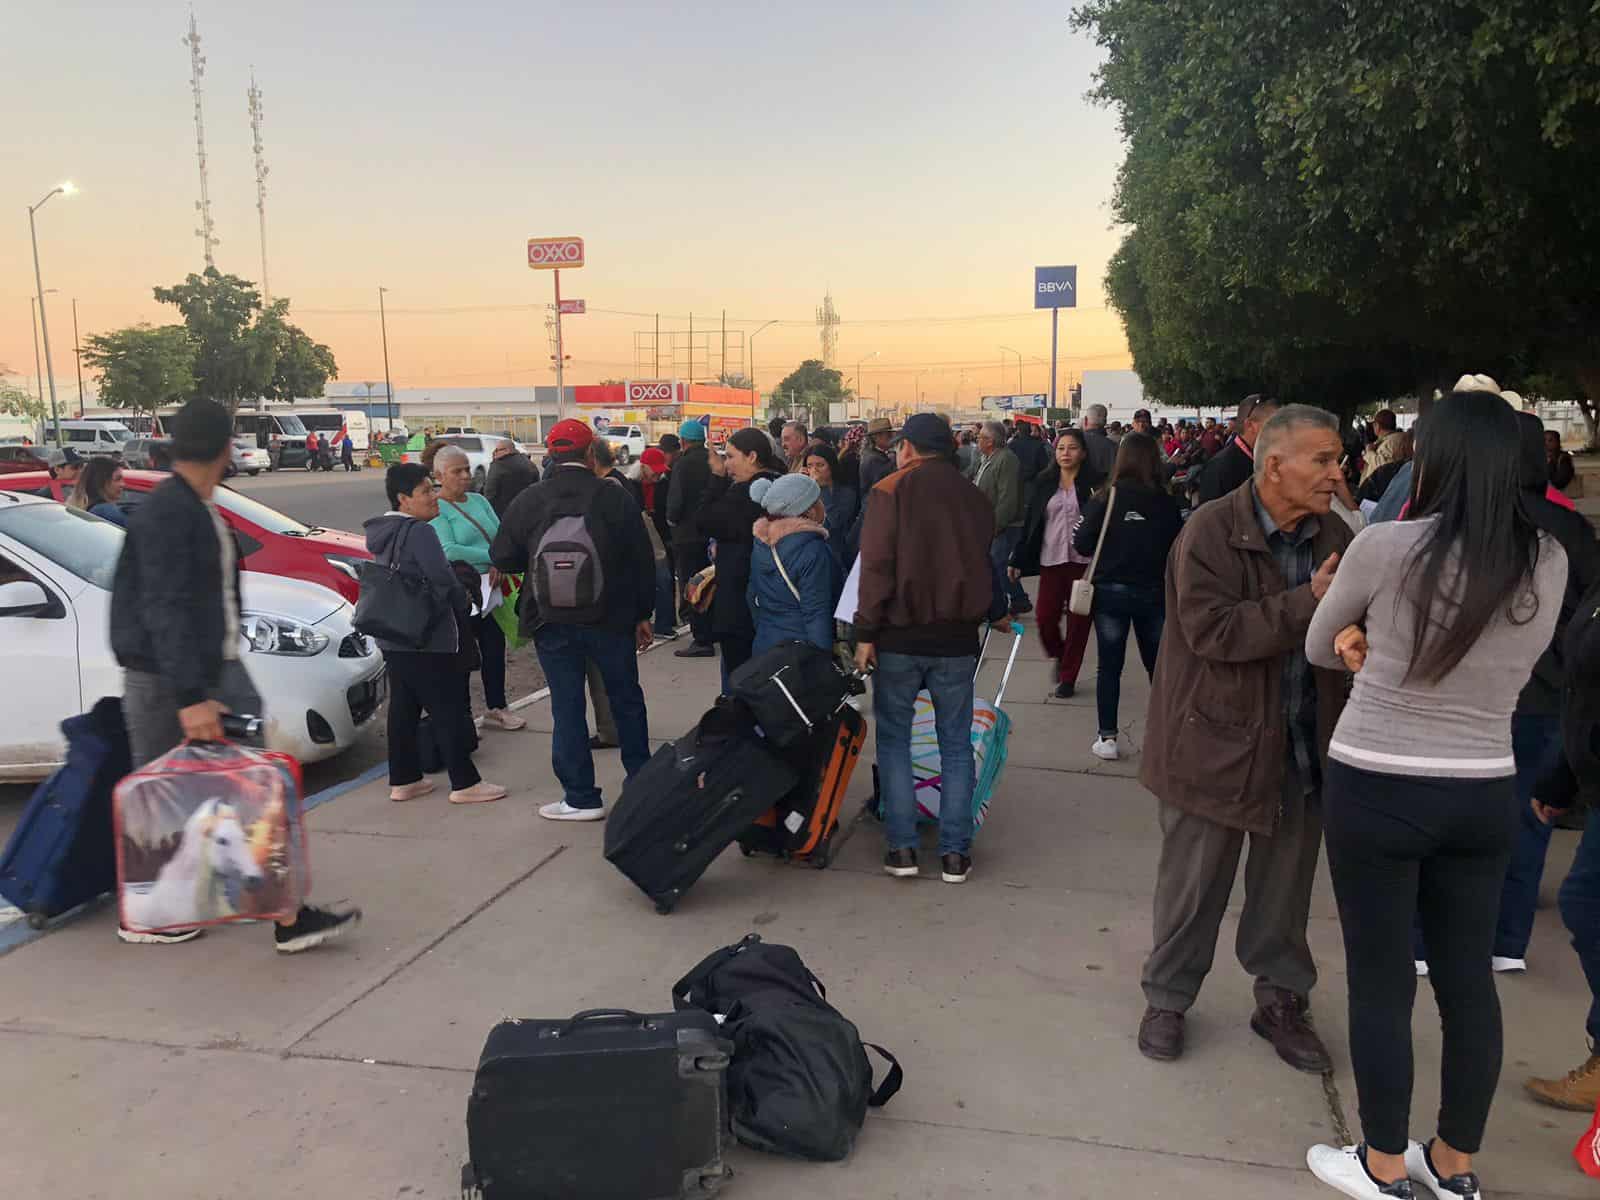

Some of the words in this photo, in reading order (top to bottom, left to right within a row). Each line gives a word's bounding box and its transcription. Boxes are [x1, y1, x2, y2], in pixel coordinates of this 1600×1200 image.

[530, 243, 580, 263] OXXO
[1038, 281, 1073, 293] BBVA
[631, 384, 671, 401] OXXO
